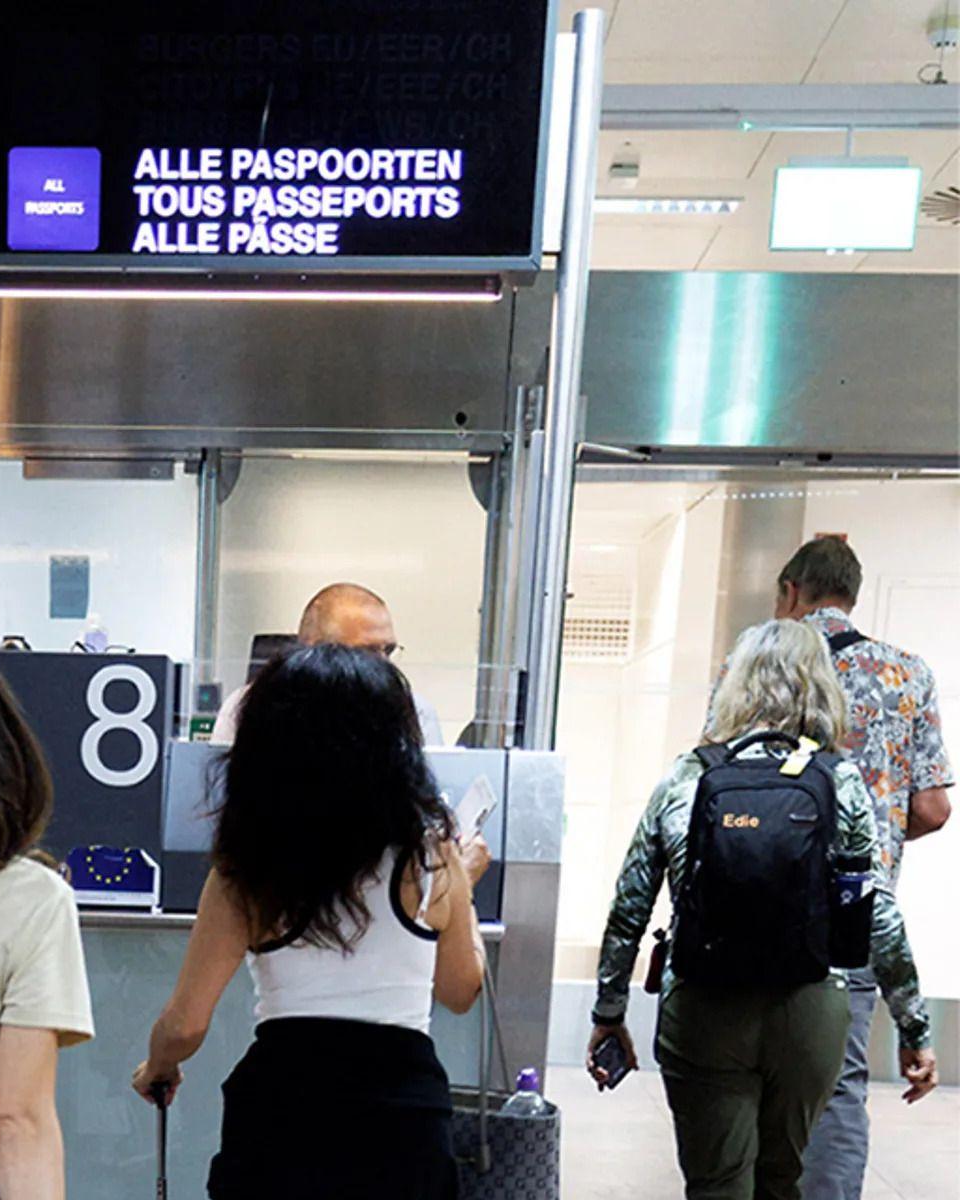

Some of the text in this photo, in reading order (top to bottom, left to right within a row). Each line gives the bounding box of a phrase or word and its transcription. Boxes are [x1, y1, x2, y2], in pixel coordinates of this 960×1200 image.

[134, 148, 462, 181] ALLE PASPOORTEN
[43, 178, 66, 192] ALL
[132, 185, 460, 218] TOUS PASSEPORTS
[132, 222, 221, 254] ALLE
[81, 664, 159, 787] 8
